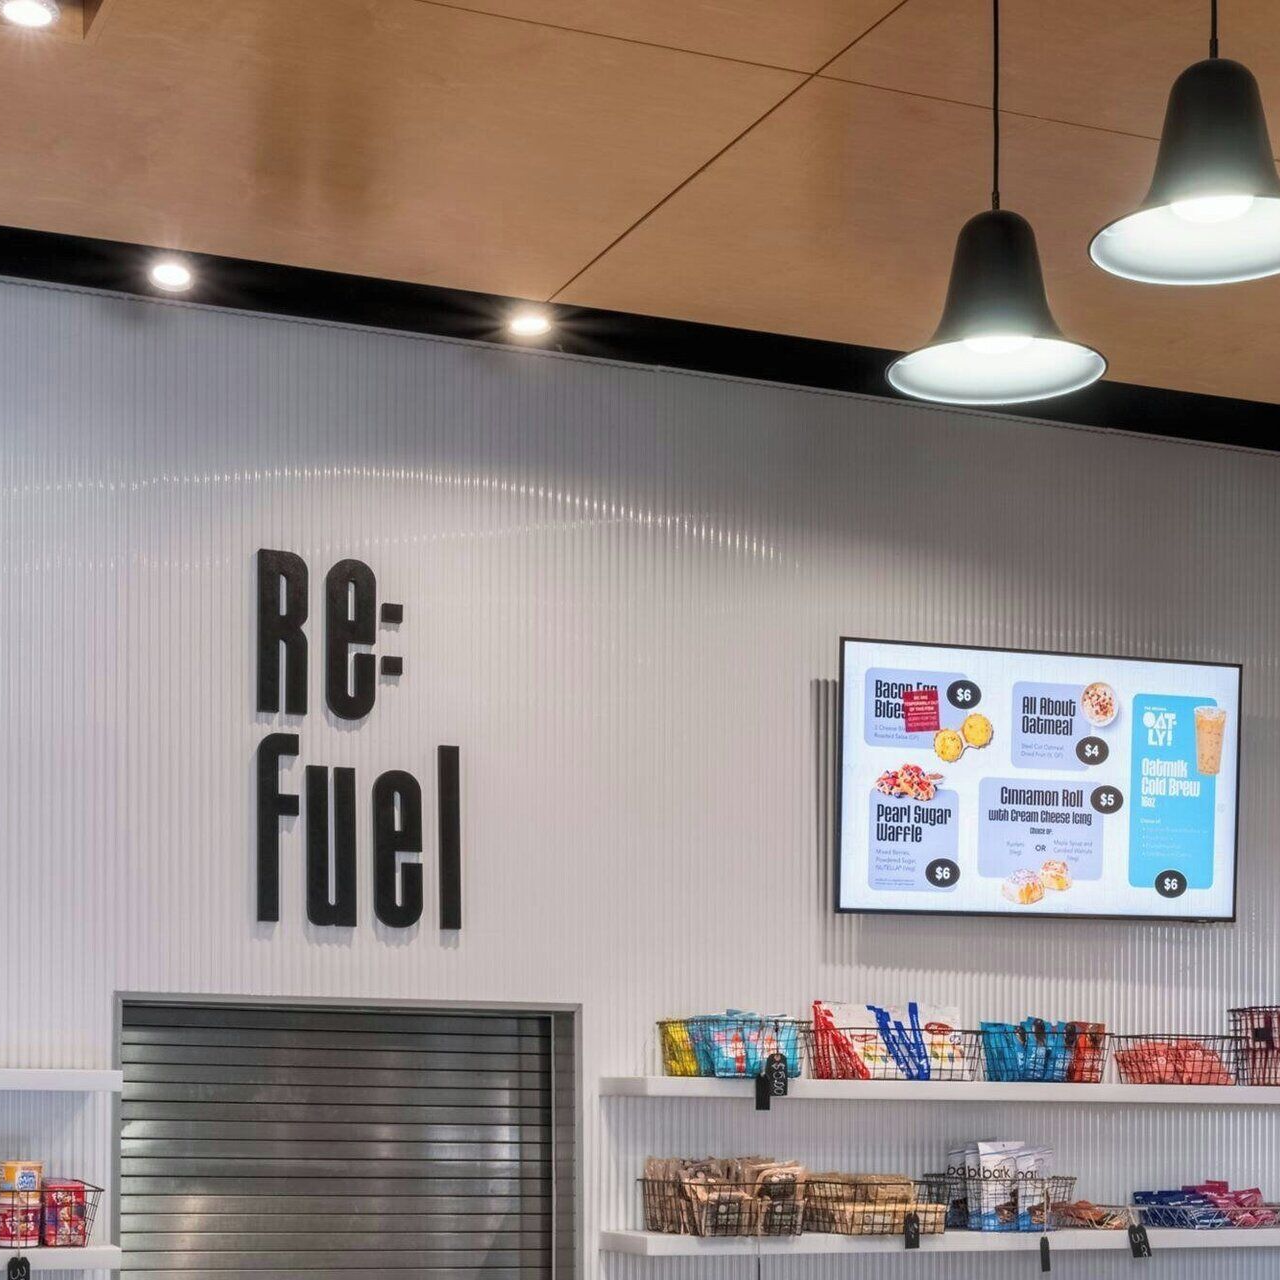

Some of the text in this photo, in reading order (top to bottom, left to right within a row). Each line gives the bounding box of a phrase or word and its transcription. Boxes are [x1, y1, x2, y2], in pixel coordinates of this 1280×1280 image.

[256, 548, 403, 720] Re:
[957, 688, 972, 702] $6
[1022, 696, 1076, 717] All About
[1022, 715, 1073, 736] Oatmeal
[1085, 744, 1099, 758] $4
[1142, 758, 1188, 778] Oatmilk
[1001, 786, 1083, 808] Cinnamon Roll
[1141, 777, 1201, 797] Cold Brew
[1100, 793, 1115, 807] $5
[877, 804, 951, 826] Pearl Sugar
[989, 808, 1092, 826] with Cream Cheese Icing
[876, 823, 922, 843] Waffle
[935, 866, 950, 880] $6
[1164, 878, 1178, 891] $6
[982, 1166, 1011, 1179] bark
